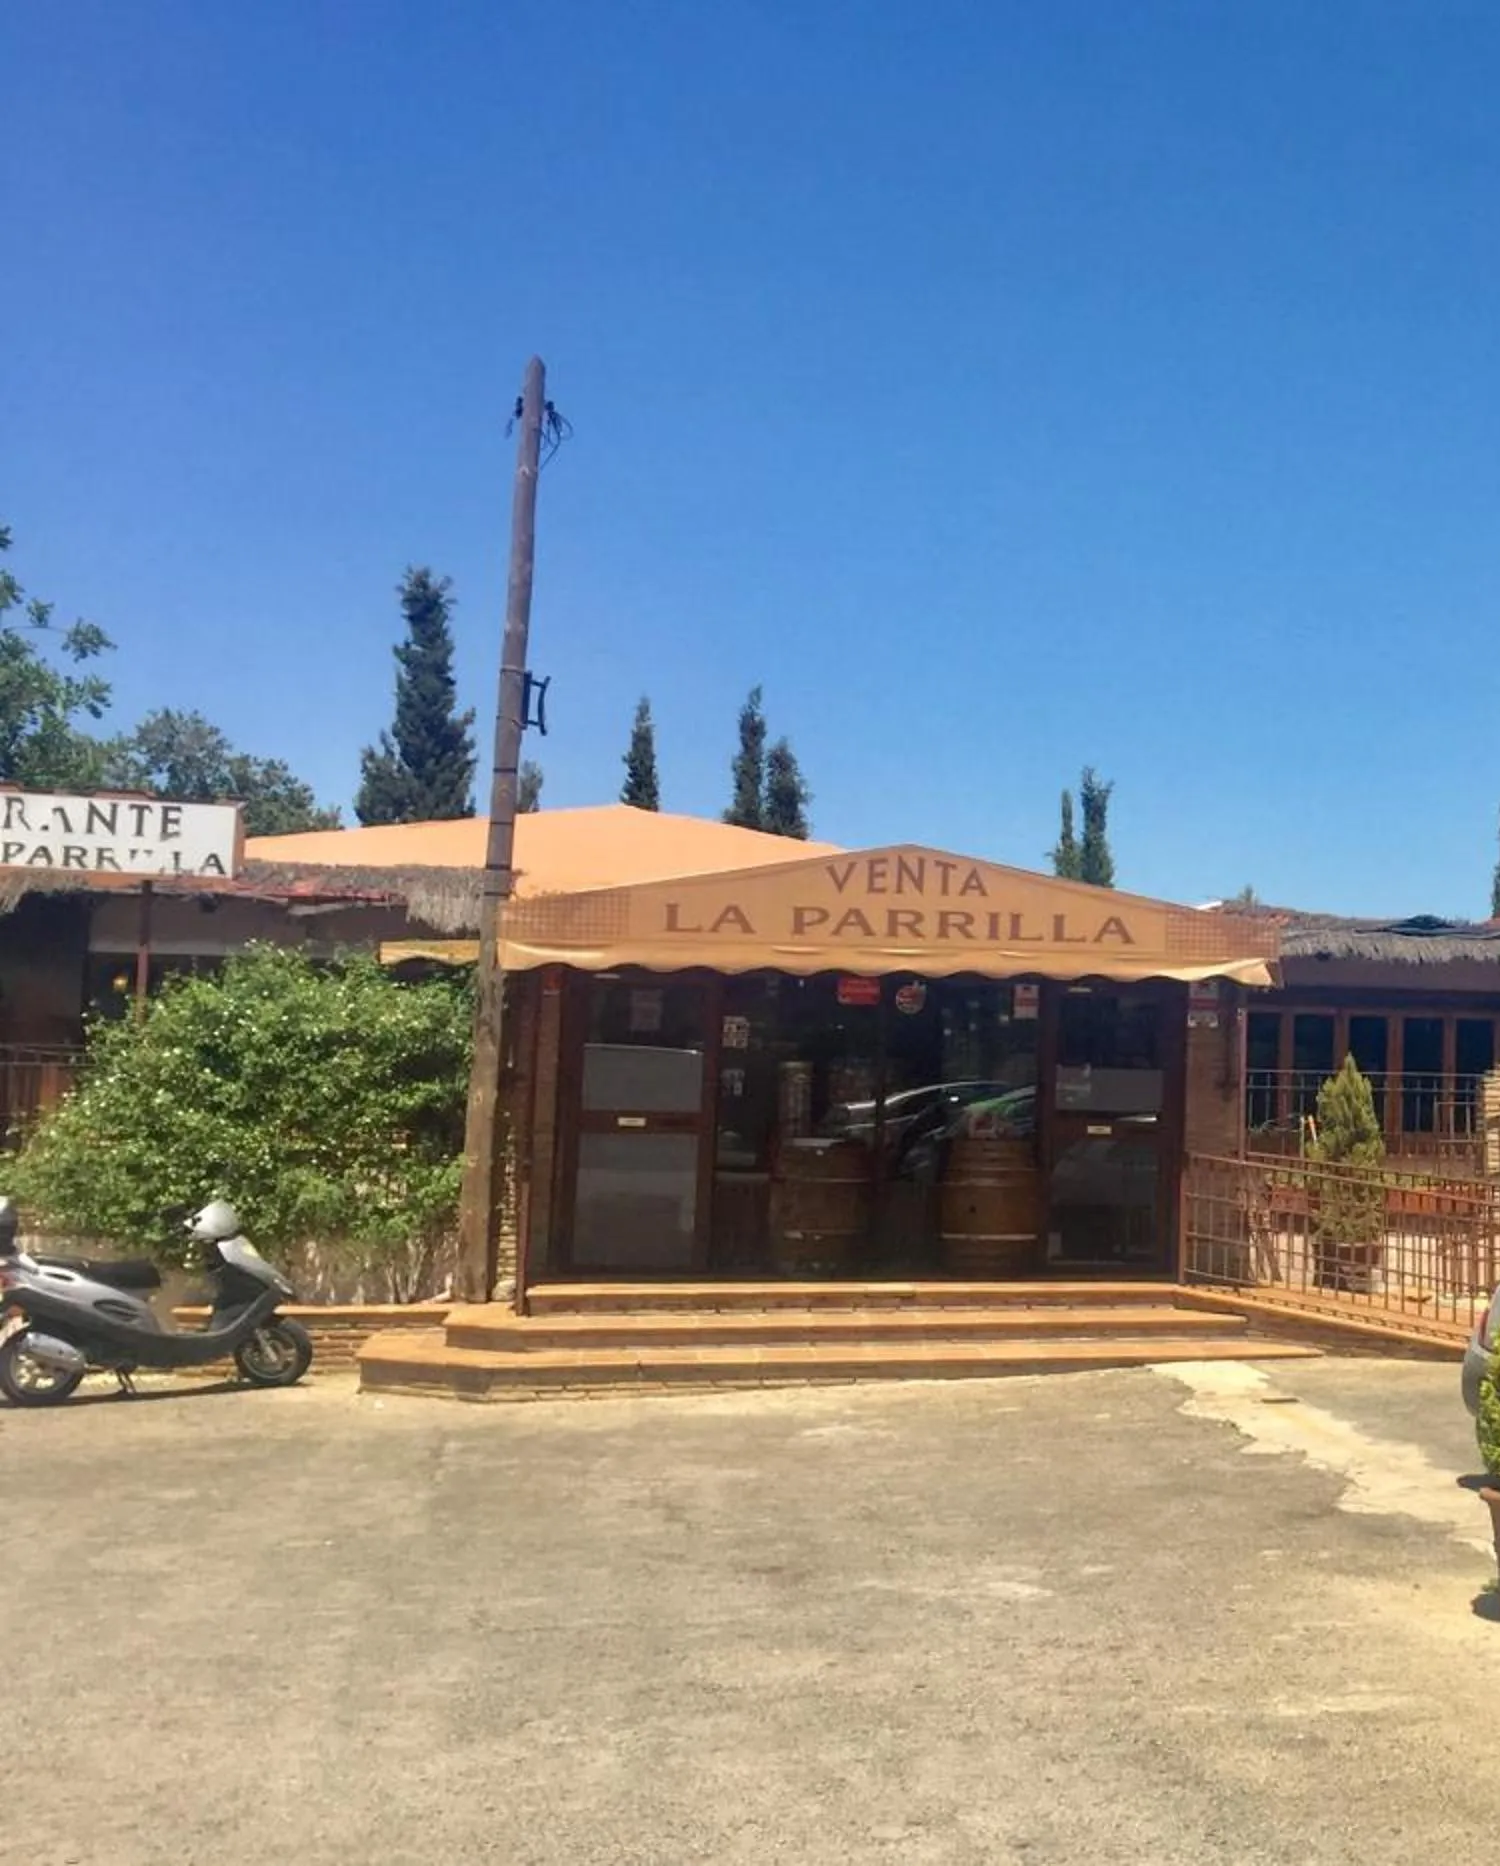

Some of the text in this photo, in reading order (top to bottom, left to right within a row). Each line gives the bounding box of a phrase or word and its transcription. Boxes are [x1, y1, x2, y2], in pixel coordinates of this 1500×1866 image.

[826, 855, 990, 897] VENTA
[664, 902, 1136, 945] LA PARRILLA
